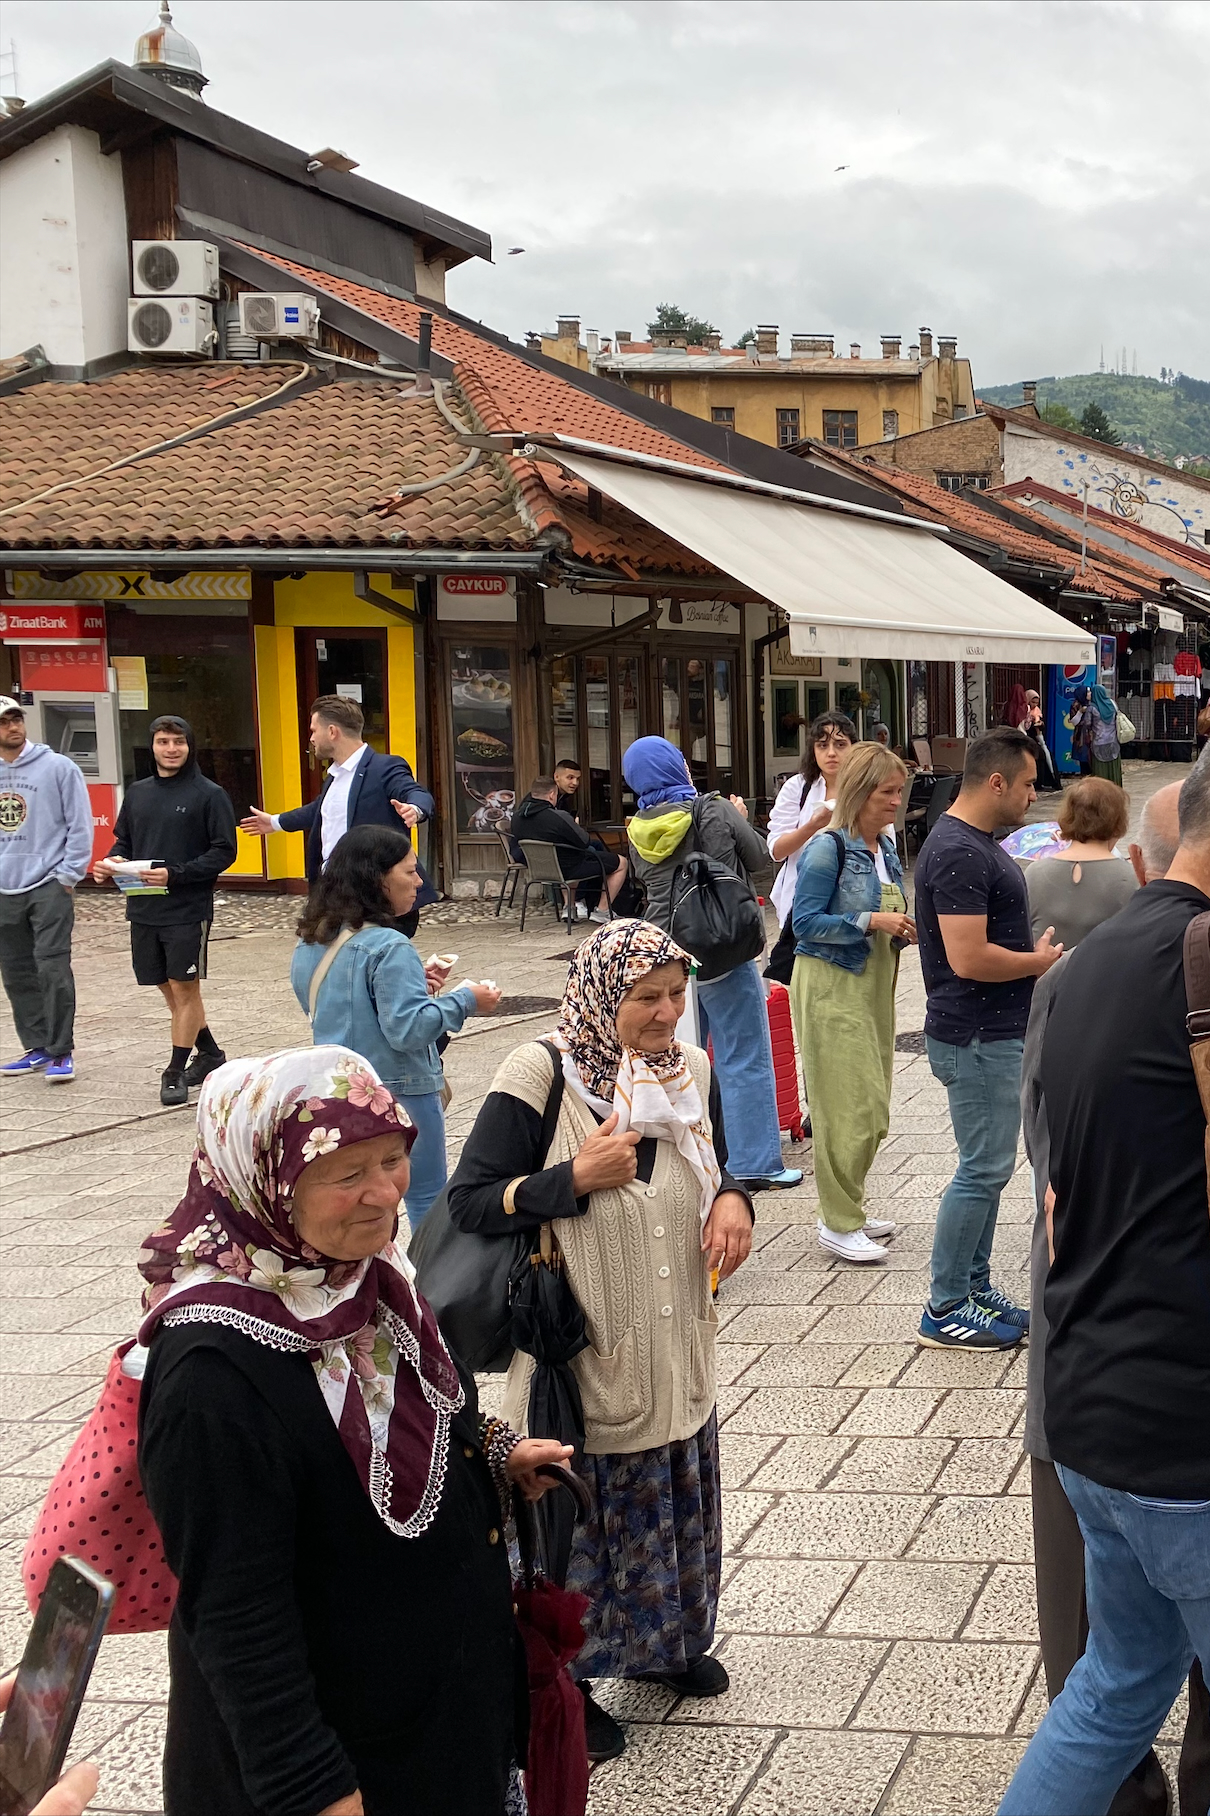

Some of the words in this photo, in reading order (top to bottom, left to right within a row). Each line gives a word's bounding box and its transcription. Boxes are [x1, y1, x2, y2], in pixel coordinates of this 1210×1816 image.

[446, 579, 503, 592] ÇAYKUR
[9, 616, 67, 628] ZiraatBank
[84, 618, 103, 628] ATM
